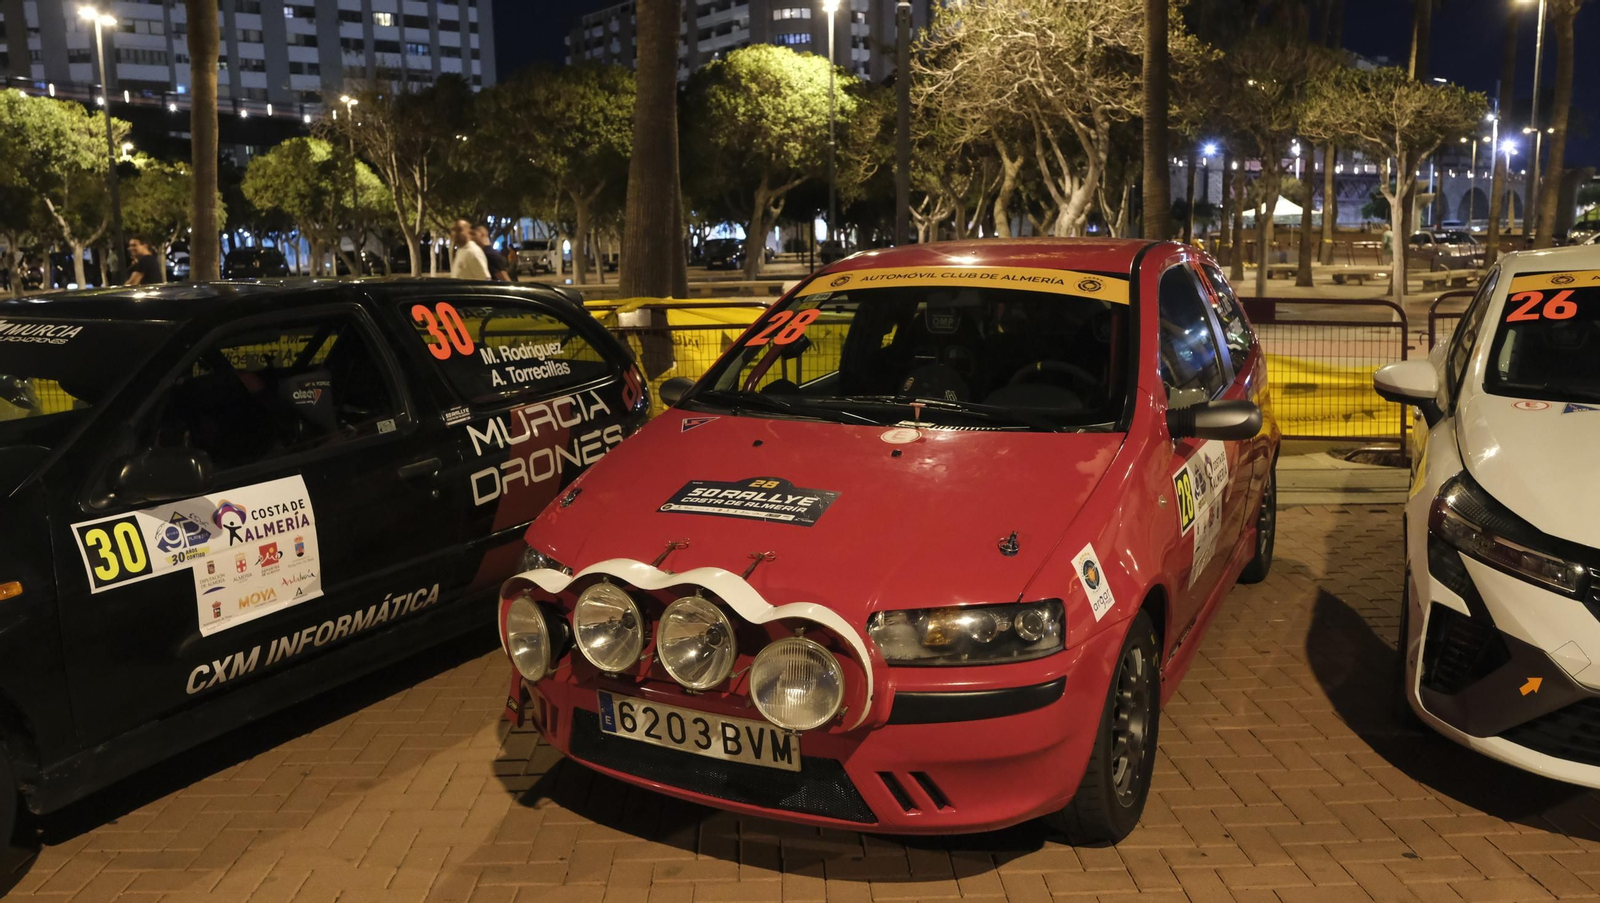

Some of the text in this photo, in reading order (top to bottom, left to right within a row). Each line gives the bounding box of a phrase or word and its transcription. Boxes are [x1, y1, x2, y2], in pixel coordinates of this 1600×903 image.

[859, 271, 1065, 286] AUTOMÓVIL CLUB DE ALMERÍA
[1506, 290, 1578, 322] 26
[3, 324, 84, 338] MURCIA
[411, 301, 475, 360] 30
[743, 308, 821, 347] 28
[931, 316, 955, 327] OMP
[480, 341, 565, 365] M. Rodríguez
[491, 360, 571, 387] A. Torrecillas
[466, 390, 611, 457] MURCIA
[470, 424, 624, 506] DRONES
[748, 479, 780, 489] 28
[680, 496, 725, 505] COSTA
[725, 499, 744, 507] DE
[743, 501, 808, 514] ALMERÍA
[687, 487, 716, 497] 50
[719, 489, 819, 507] RALLYE
[1176, 473, 1195, 527] 28
[251, 499, 306, 521] COSTA DE
[244, 513, 310, 543] ALMERÍA
[84, 521, 147, 581] 30
[171, 552, 185, 566] 30
[186, 552, 206, 561] CONTIGO
[238, 587, 277, 610] MOYA
[264, 583, 440, 667] INFORMÁTICA
[186, 645, 261, 695] CXM
[605, 715, 612, 725] E
[618, 701, 793, 765] 6203 BVM
